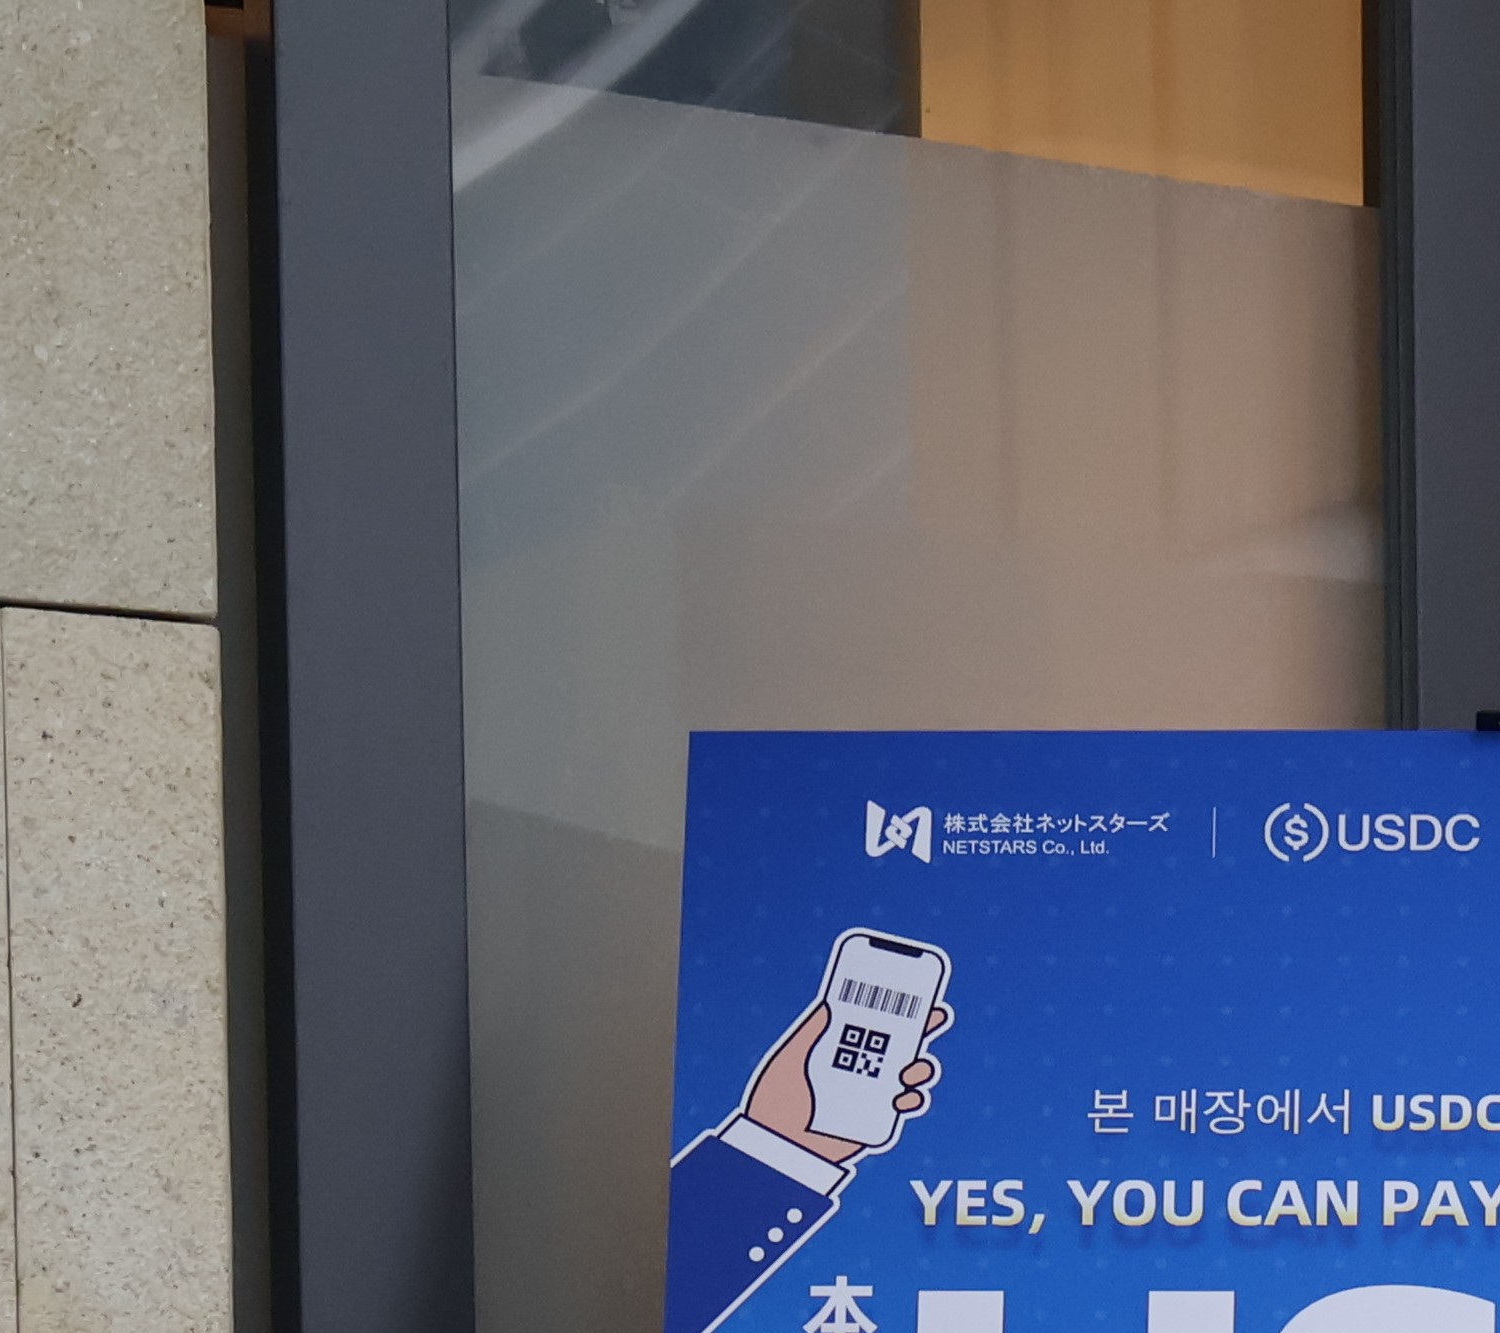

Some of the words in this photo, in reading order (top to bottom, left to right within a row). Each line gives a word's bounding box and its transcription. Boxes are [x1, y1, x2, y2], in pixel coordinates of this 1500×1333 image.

[943, 812, 1170, 834] 株式会社ネットスターズ
[1338, 813, 1480, 852] USDC
[943, 839, 1037, 855] NETSTARS
[1042, 839, 1075, 857] Co.,
[1080, 840, 1109, 855] Ltd.
[1087, 1089, 1130, 1133] 본
[1155, 1088, 1351, 1135] 매장에서
[909, 1180, 1045, 1235] YES,
[1066, 1180, 1205, 1228] YOU
[1227, 1180, 1359, 1228] CAN
